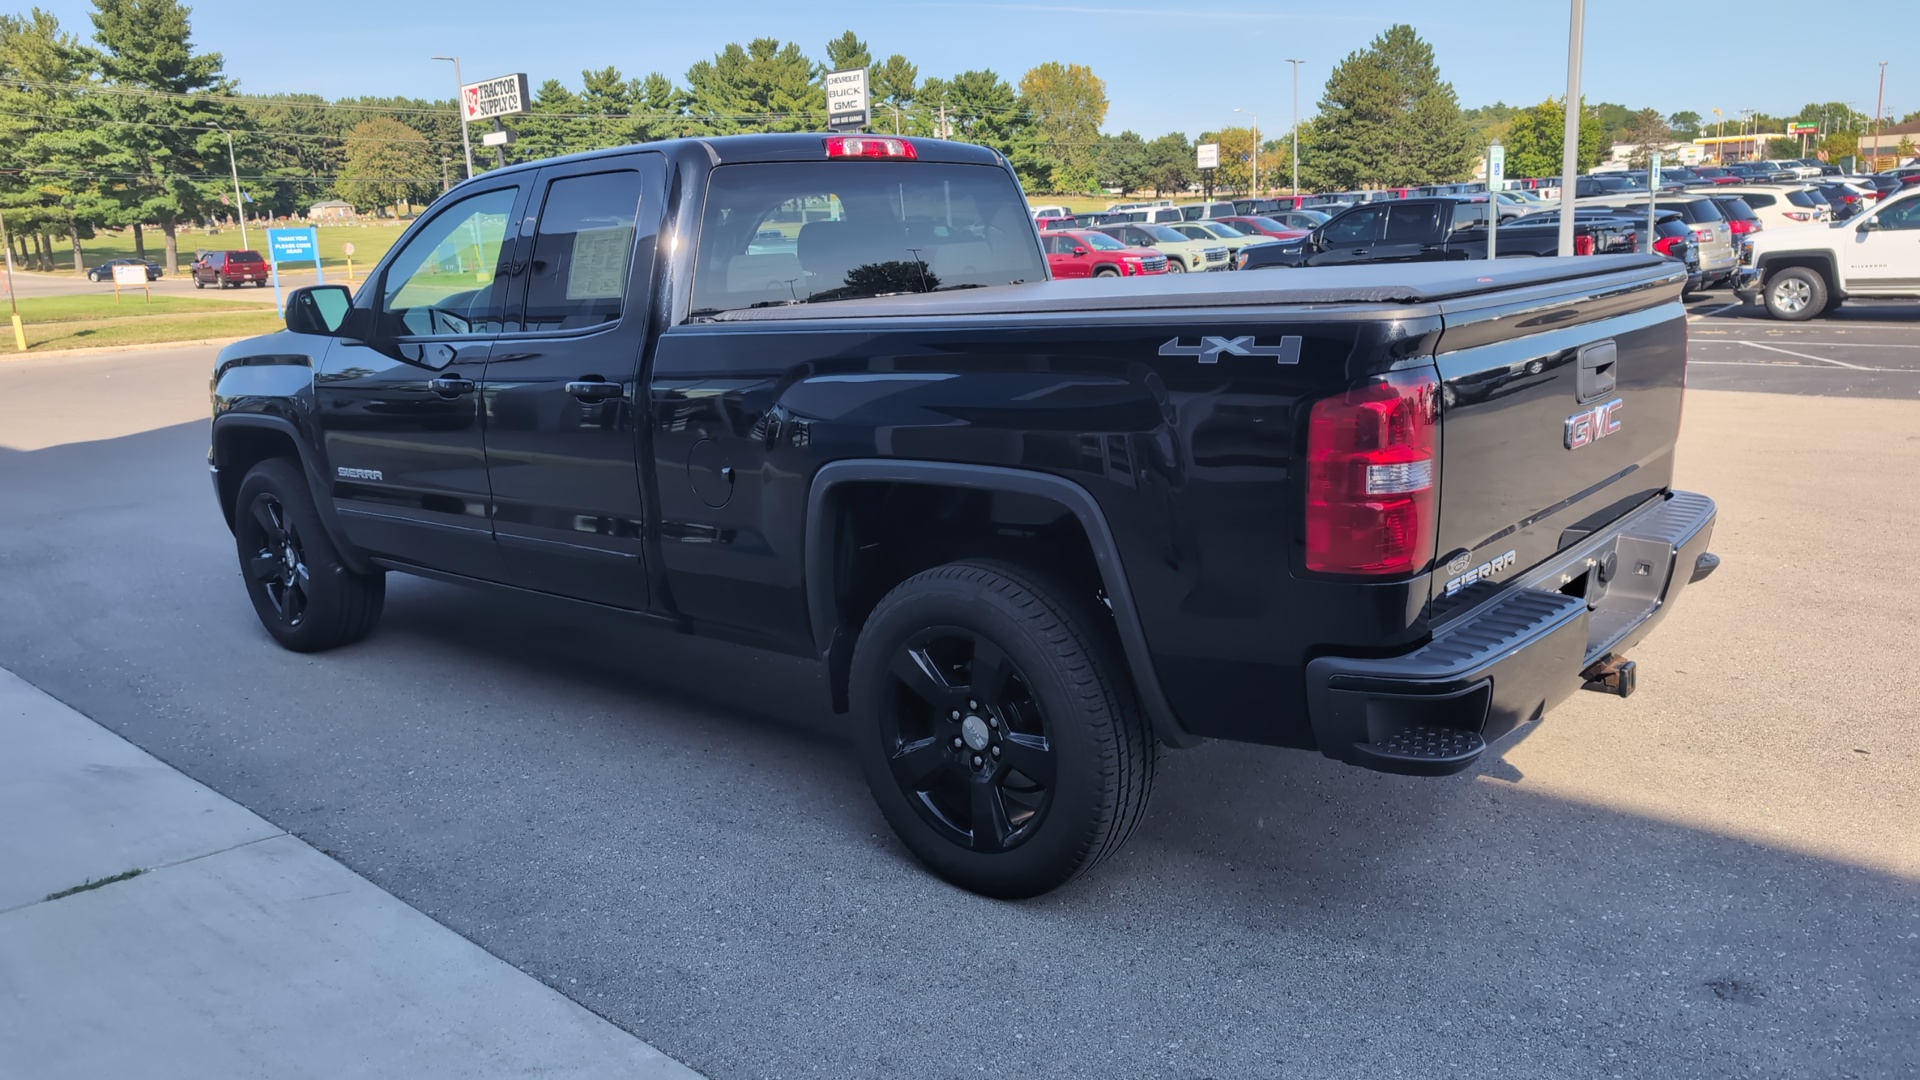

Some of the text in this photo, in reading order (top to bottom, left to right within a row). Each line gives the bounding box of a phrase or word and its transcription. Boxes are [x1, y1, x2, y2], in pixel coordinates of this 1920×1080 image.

[829, 74, 860, 85] CHEVROLET
[478, 78, 516, 99] TRACTOR
[829, 87, 861, 98] BUICK
[480, 96, 508, 115] SUPPLY
[834, 100, 858, 110] GMC
[1569, 398, 1623, 450] GMC
[337, 466, 383, 481] SIERRA
[1445, 549, 1516, 598] SIERRA
